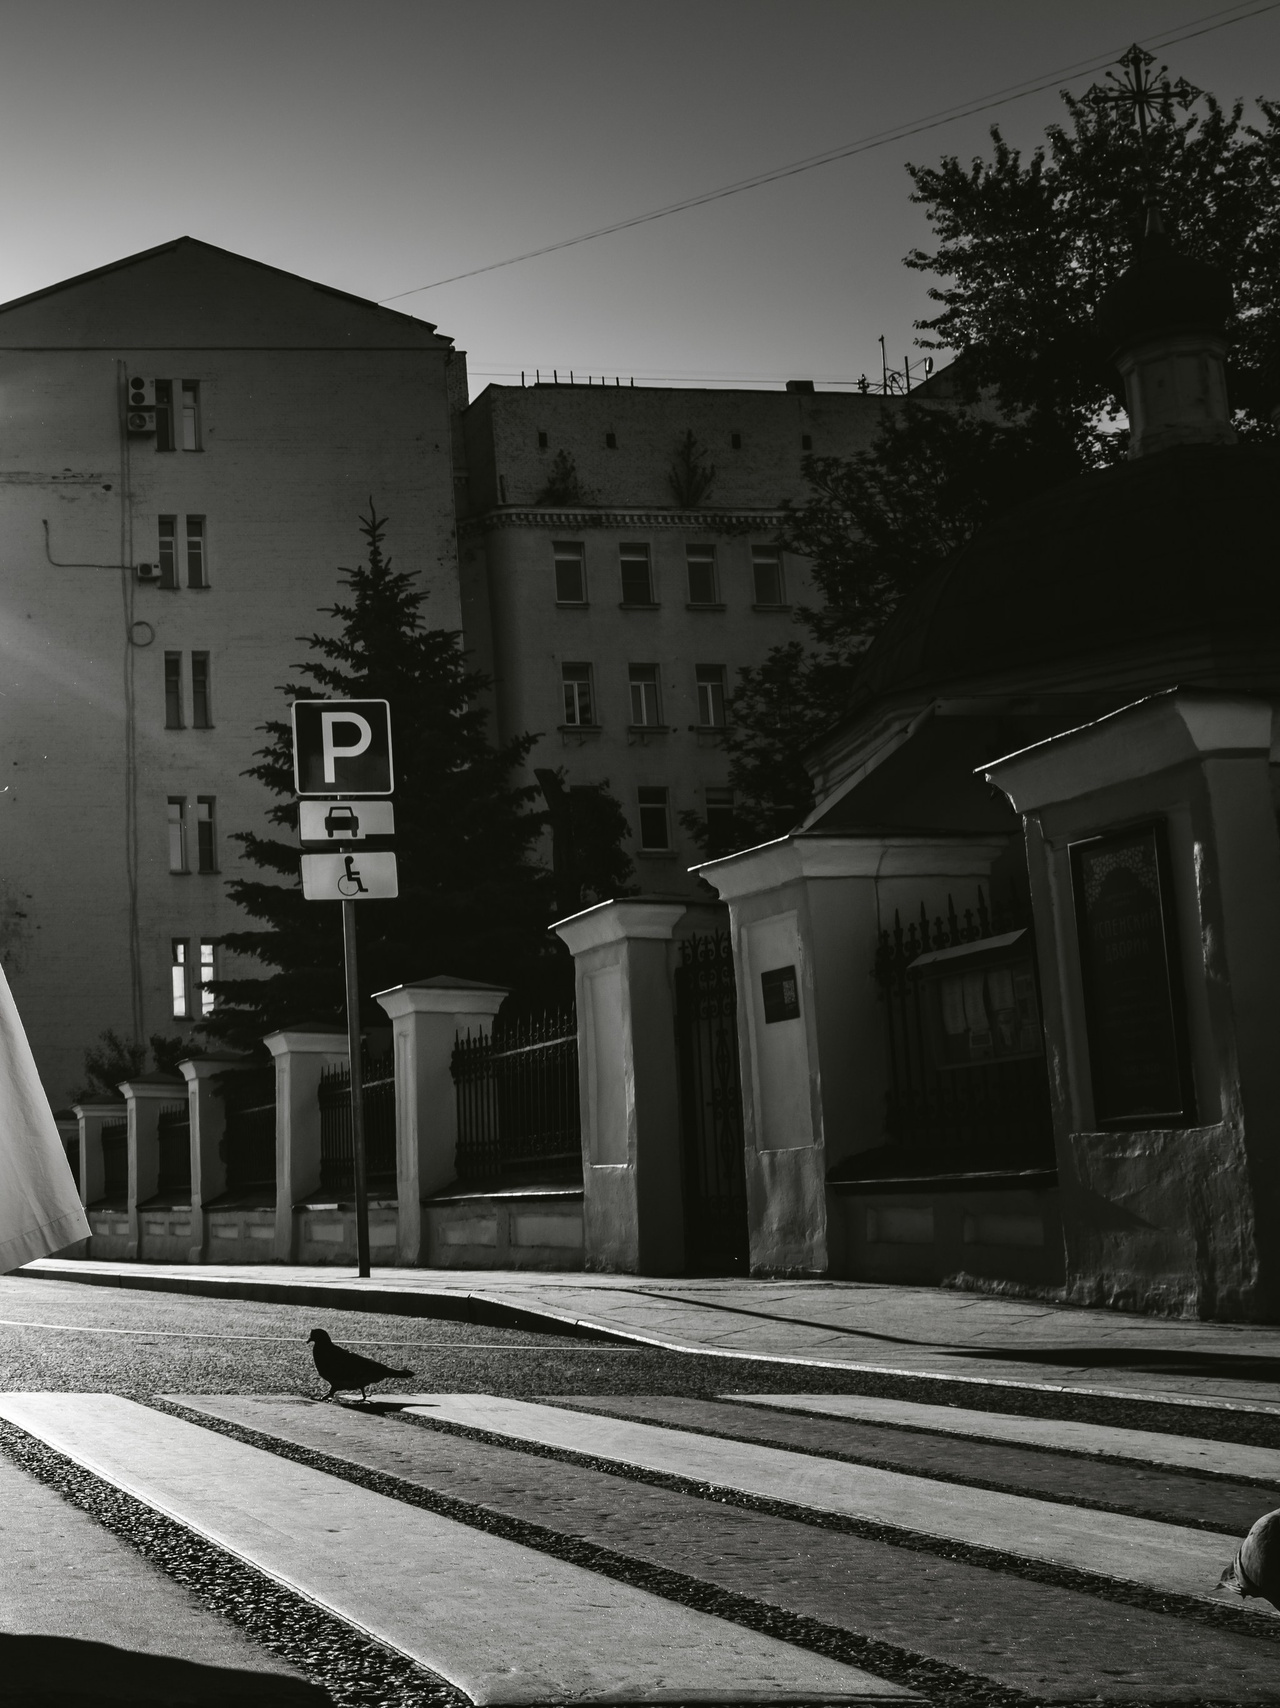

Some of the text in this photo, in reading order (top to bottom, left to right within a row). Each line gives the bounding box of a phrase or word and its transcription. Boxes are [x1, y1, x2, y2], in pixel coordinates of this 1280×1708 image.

[321, 711, 372, 783] P
[1093, 907, 1158, 939] УСПЕНСКИЙ
[1105, 937, 1149, 964] ДВОРИК
